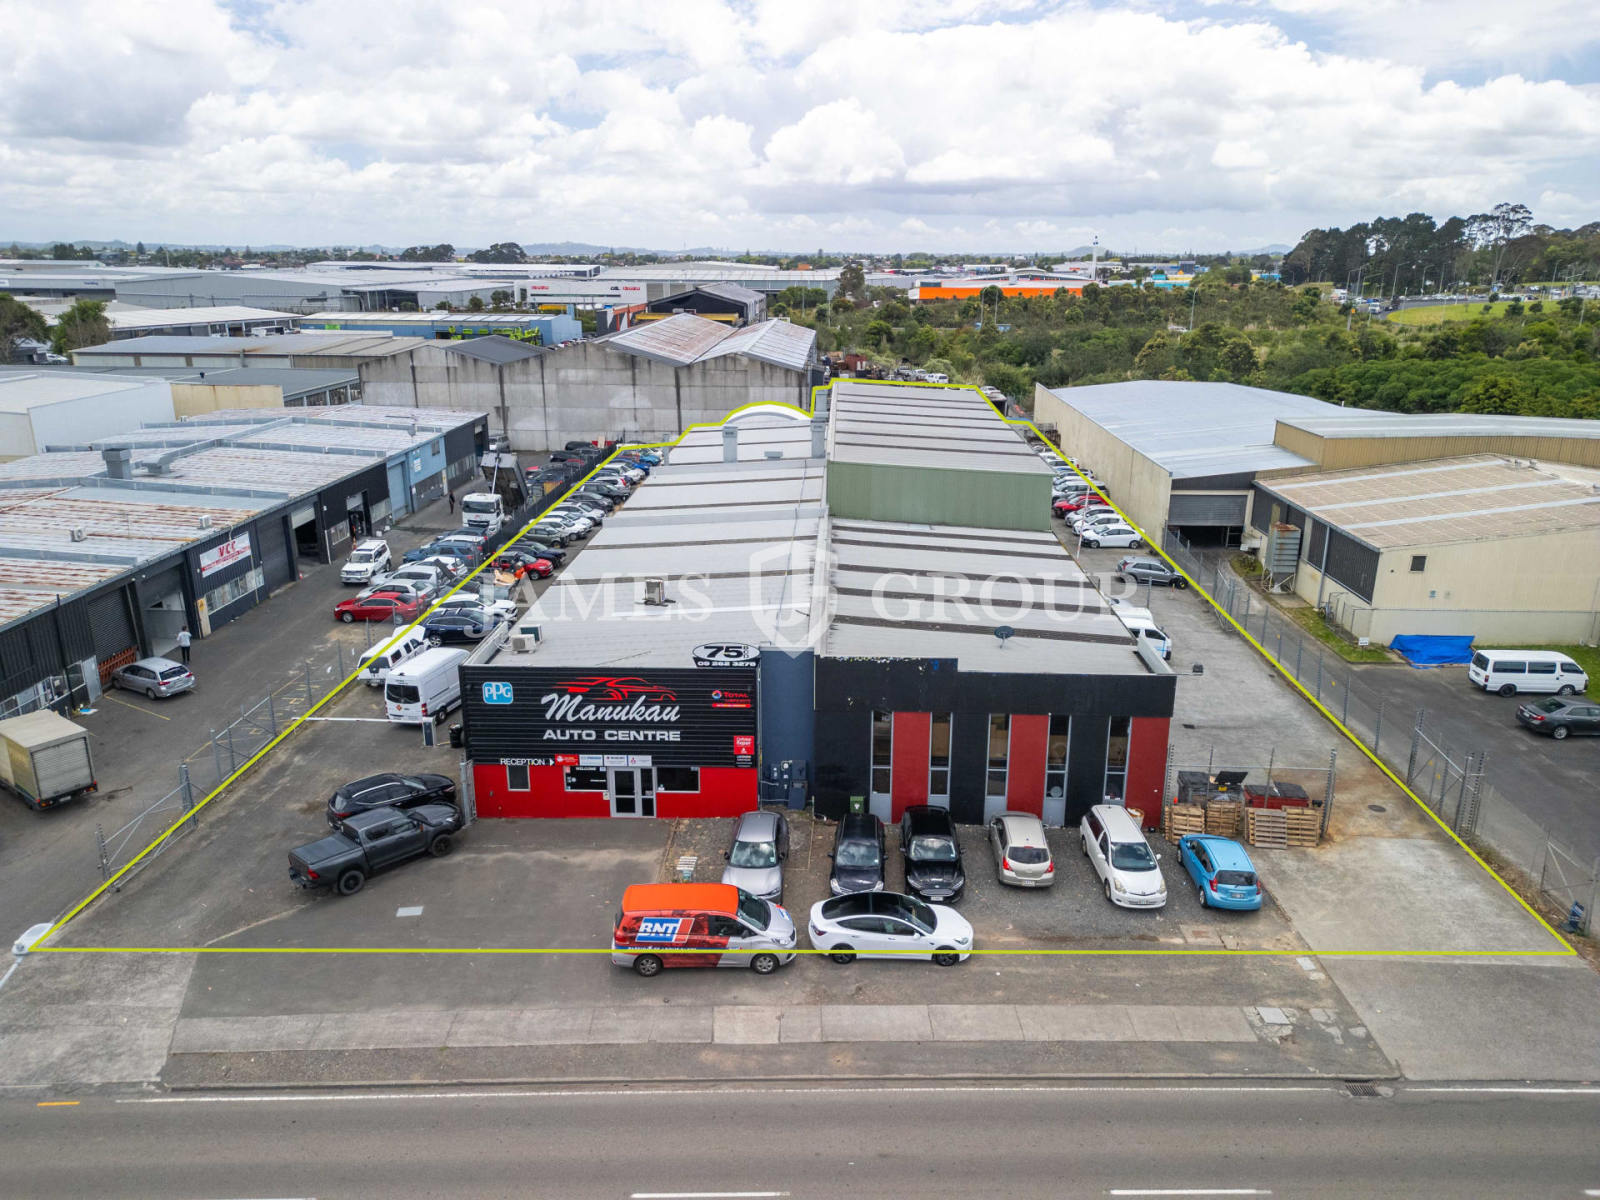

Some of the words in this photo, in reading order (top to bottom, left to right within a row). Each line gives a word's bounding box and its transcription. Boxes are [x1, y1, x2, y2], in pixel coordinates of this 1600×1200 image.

[218, 540, 236, 557] VCC
[703, 645, 743, 658] 75
[485, 682, 511, 700] PPG
[541, 693, 681, 722] Manukau
[543, 729, 596, 741] AUTO
[604, 730, 681, 741] CENTRE
[500, 758, 545, 766] RECEPTION
[639, 922, 679, 937] RNT
